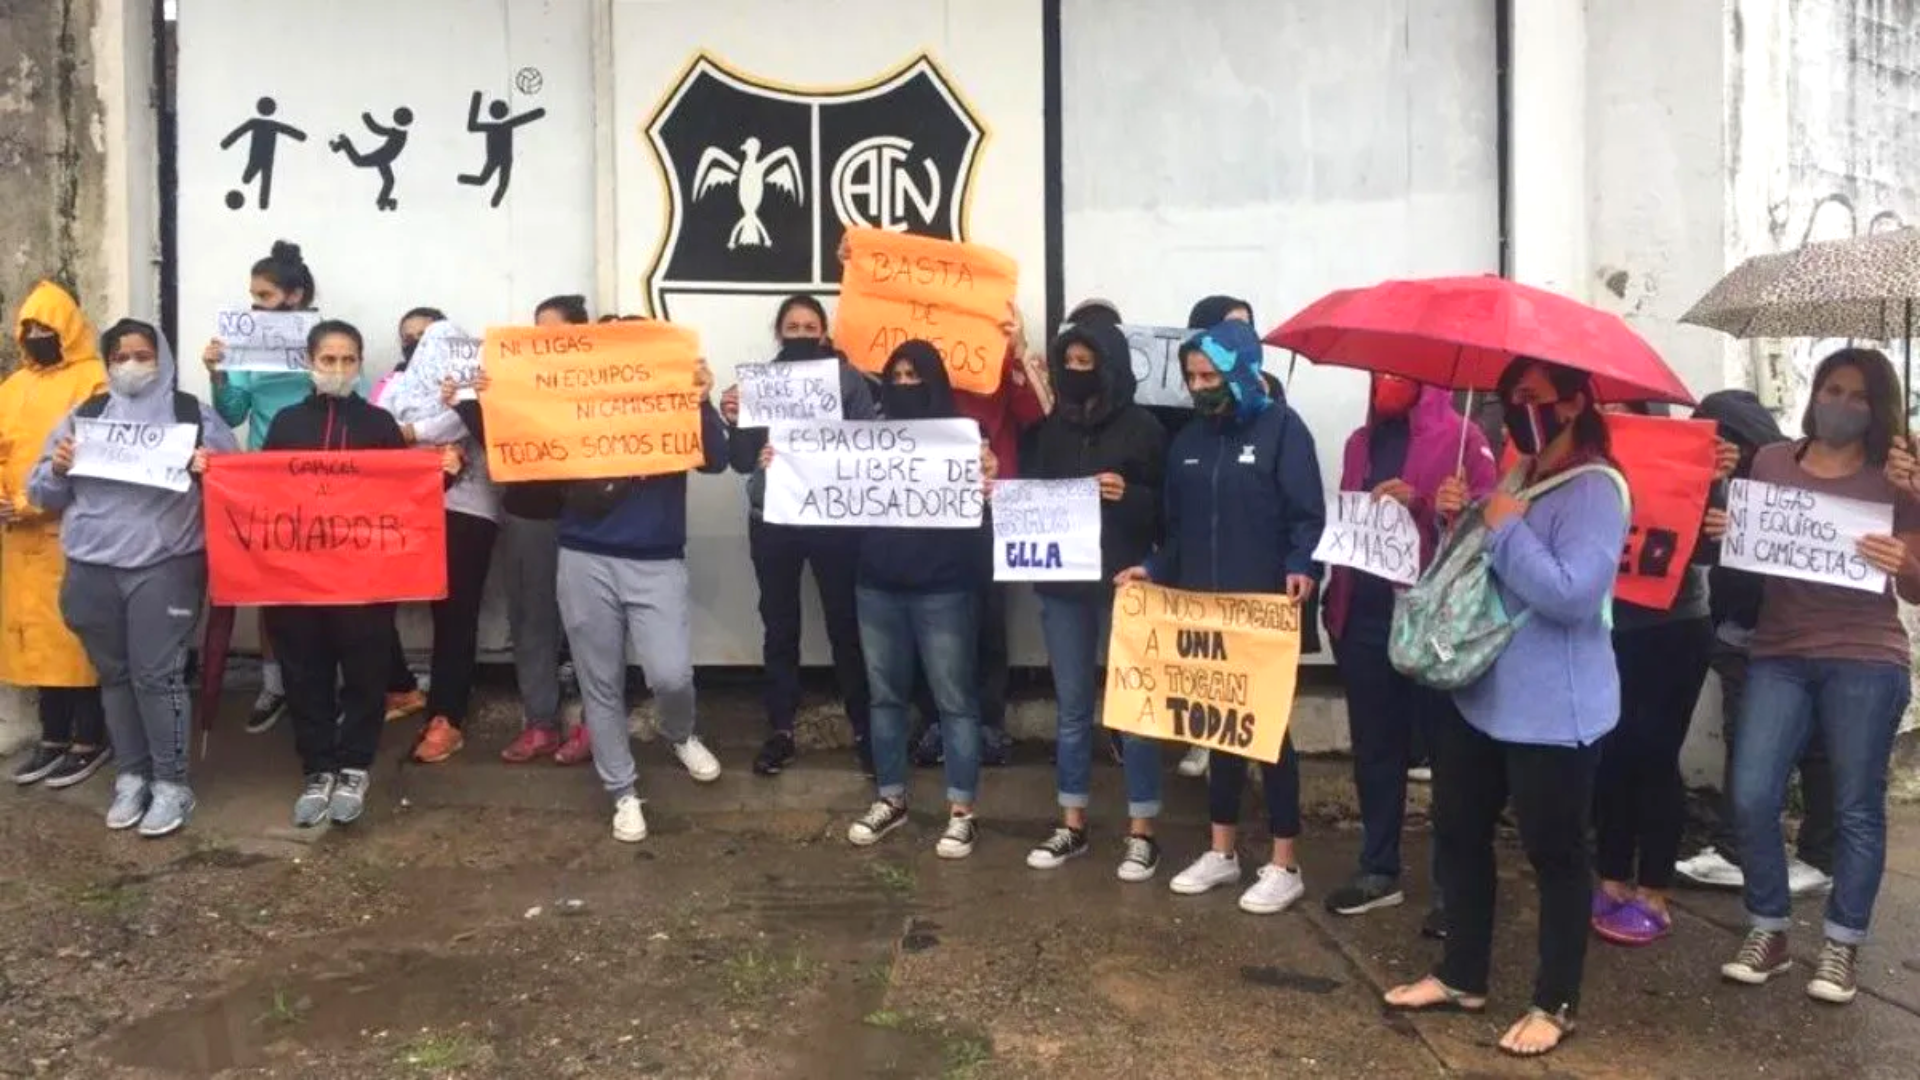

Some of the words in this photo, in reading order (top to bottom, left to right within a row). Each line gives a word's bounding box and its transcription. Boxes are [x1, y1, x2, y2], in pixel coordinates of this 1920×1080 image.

[870, 253, 974, 290] BASTA
[219, 312, 255, 337] NO
[909, 300, 939, 325] DE
[500, 340, 521, 358] NI
[532, 336, 594, 355] LIGAS
[536, 371, 558, 389] NI
[562, 363, 651, 388] EQUIPOS
[577, 402, 596, 420] NI
[599, 392, 700, 417] CAMISETAS
[494, 439, 569, 464] TODAS
[581, 434, 654, 458] SOMOS
[789, 427, 916, 452] ESPACIOS
[836, 457, 925, 483] LIBRE
[945, 458, 977, 483] DE
[799, 486, 984, 519] ABUSADORES
[1732, 482, 1749, 502] NI
[1006, 541, 1063, 569] ELLA
[1123, 585, 1147, 616] SI
[1162, 596, 1206, 621] NOS
[1144, 629, 1160, 659] A
[1176, 630, 1228, 661] UNA
[1115, 666, 1157, 692] NOS
[1136, 697, 1156, 725] A
[1166, 697, 1256, 749] TODAS
